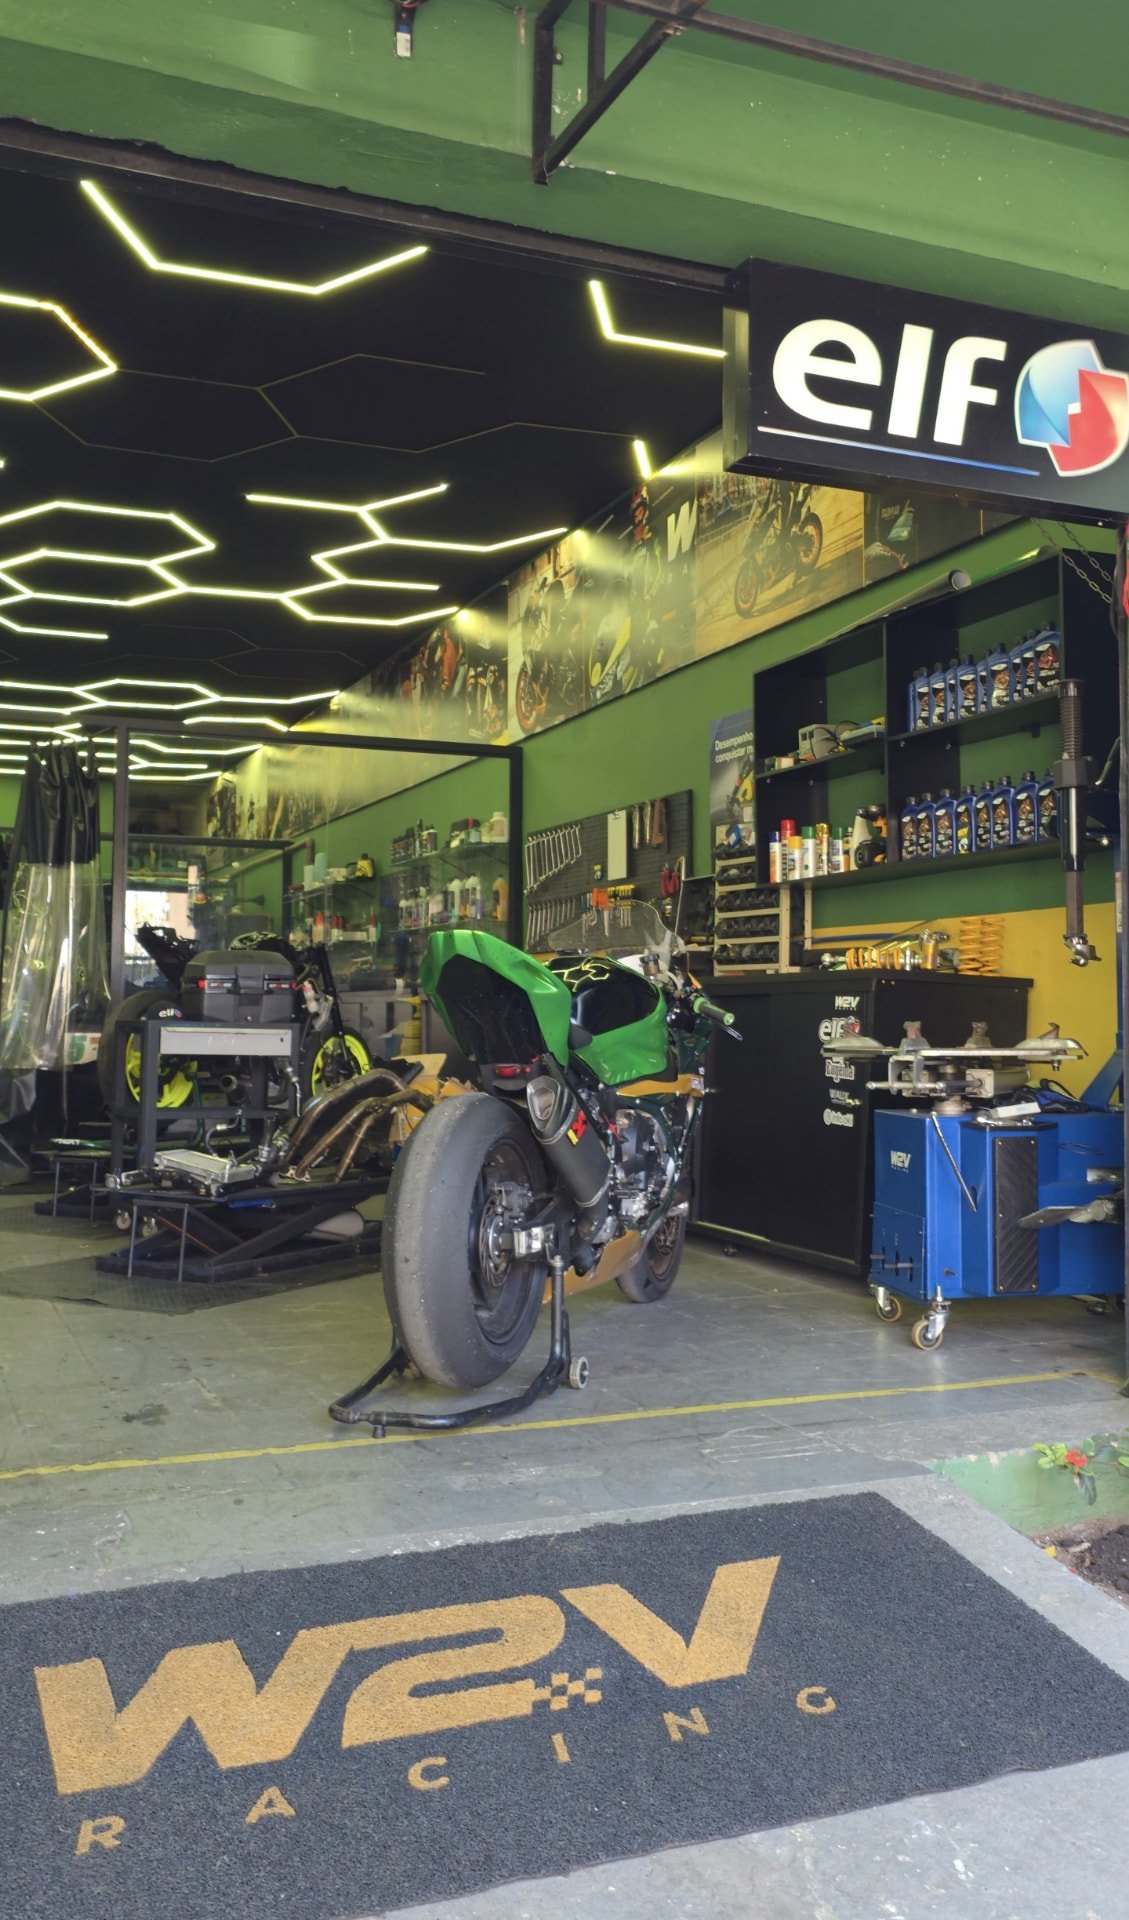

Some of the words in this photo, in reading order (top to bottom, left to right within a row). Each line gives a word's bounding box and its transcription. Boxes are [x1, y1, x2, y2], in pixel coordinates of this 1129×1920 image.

[772, 319, 1008, 446] elf
[714, 731, 754, 751] Desempenho
[715, 747, 746, 763] conquistar
[835, 996, 860, 1008] W2V
[158, 1008, 174, 1018] elf
[818, 1018, 846, 1042] elf
[890, 1150, 911, 1168] W2V
[34, 1555, 781, 1796] W2V
[75, 1686, 836, 1856] RACING
